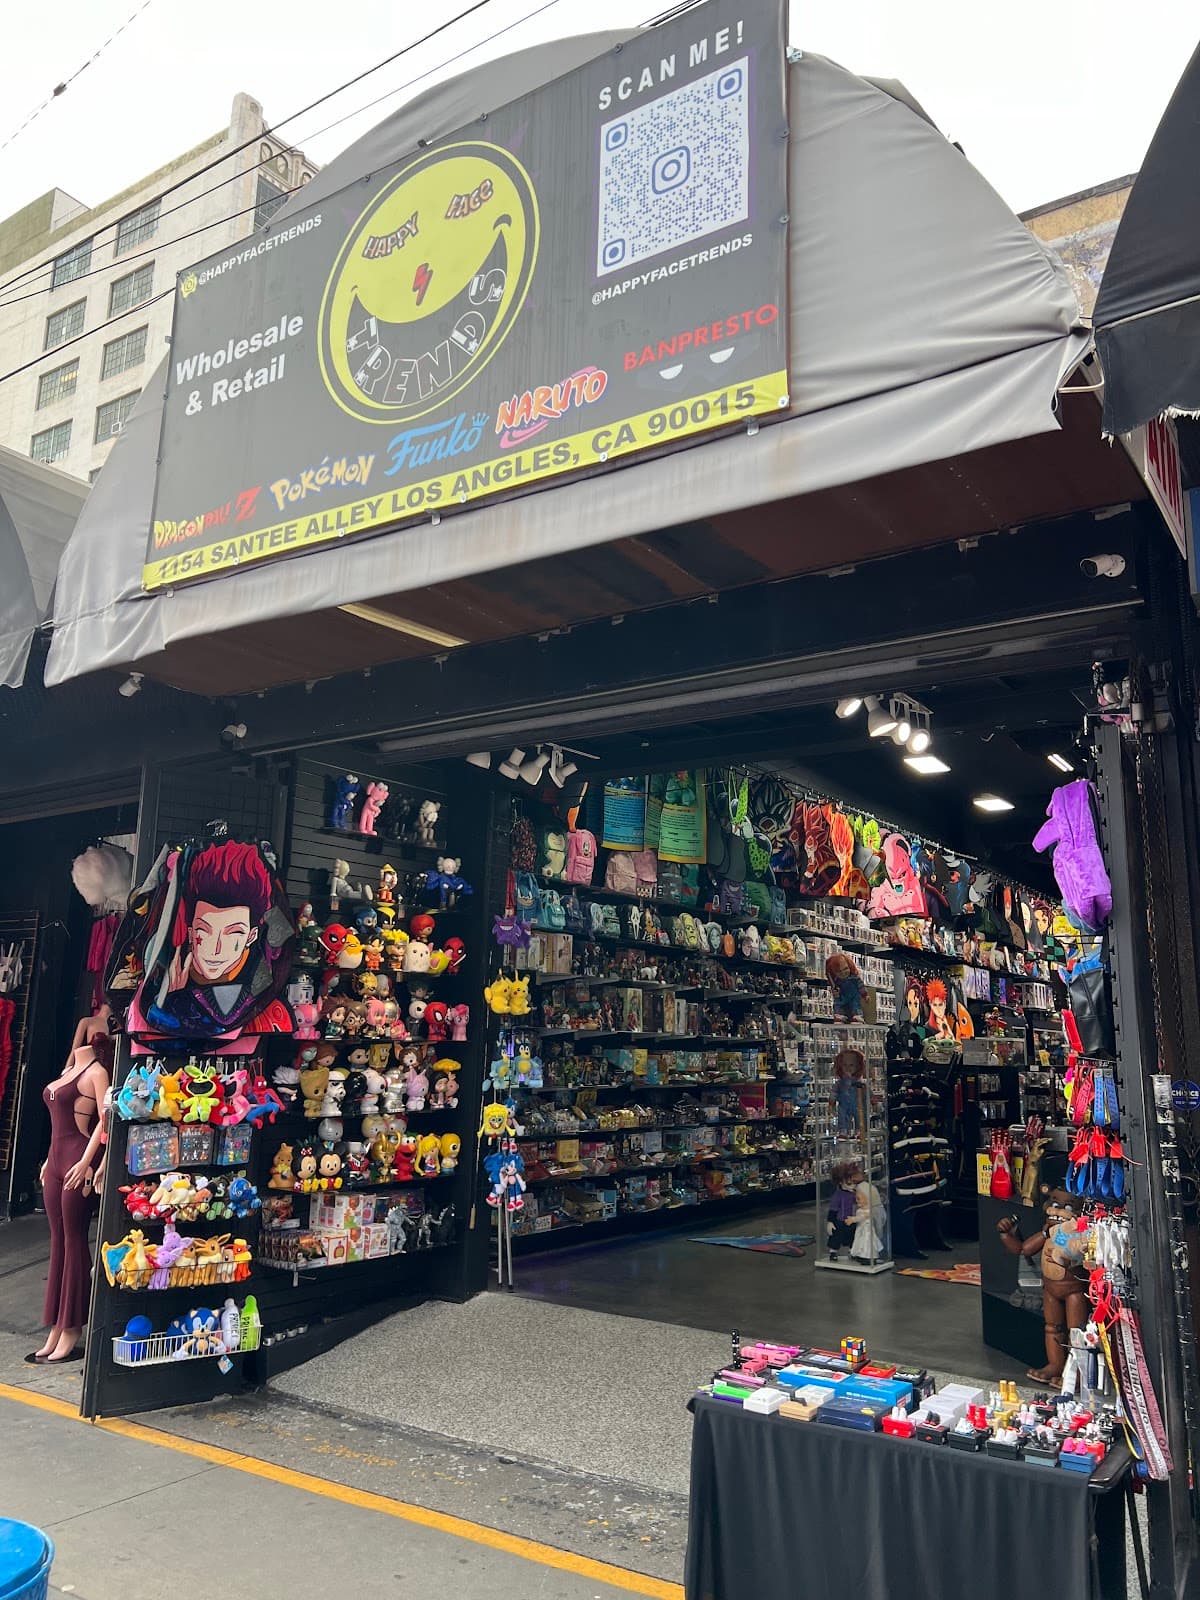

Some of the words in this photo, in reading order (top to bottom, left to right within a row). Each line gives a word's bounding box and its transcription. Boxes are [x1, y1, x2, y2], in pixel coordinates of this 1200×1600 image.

[598, 54, 676, 111] SCAN
[688, 20, 745, 68] ME!
[199, 214, 323, 286] @HAPPYFACETRENDS
[362, 211, 420, 260] HAPPY
[591, 233, 753, 306] @HAPPYFACETRENDS
[175, 314, 304, 386] Wholesale
[623, 303, 778, 373] BANPRESTO
[185, 390, 204, 417] &
[211, 353, 287, 407] Retail
[494, 369, 608, 434] NARUTO
[384, 412, 490, 477] Funko
[158, 550, 205, 579] 1154
[210, 527, 297, 566] SANTEE
[303, 498, 385, 539] ALLEY
[391, 478, 443, 515] LOS
[451, 441, 581, 498] ANGLES,
[591, 423, 637, 454] CA
[647, 384, 756, 437] 90015
